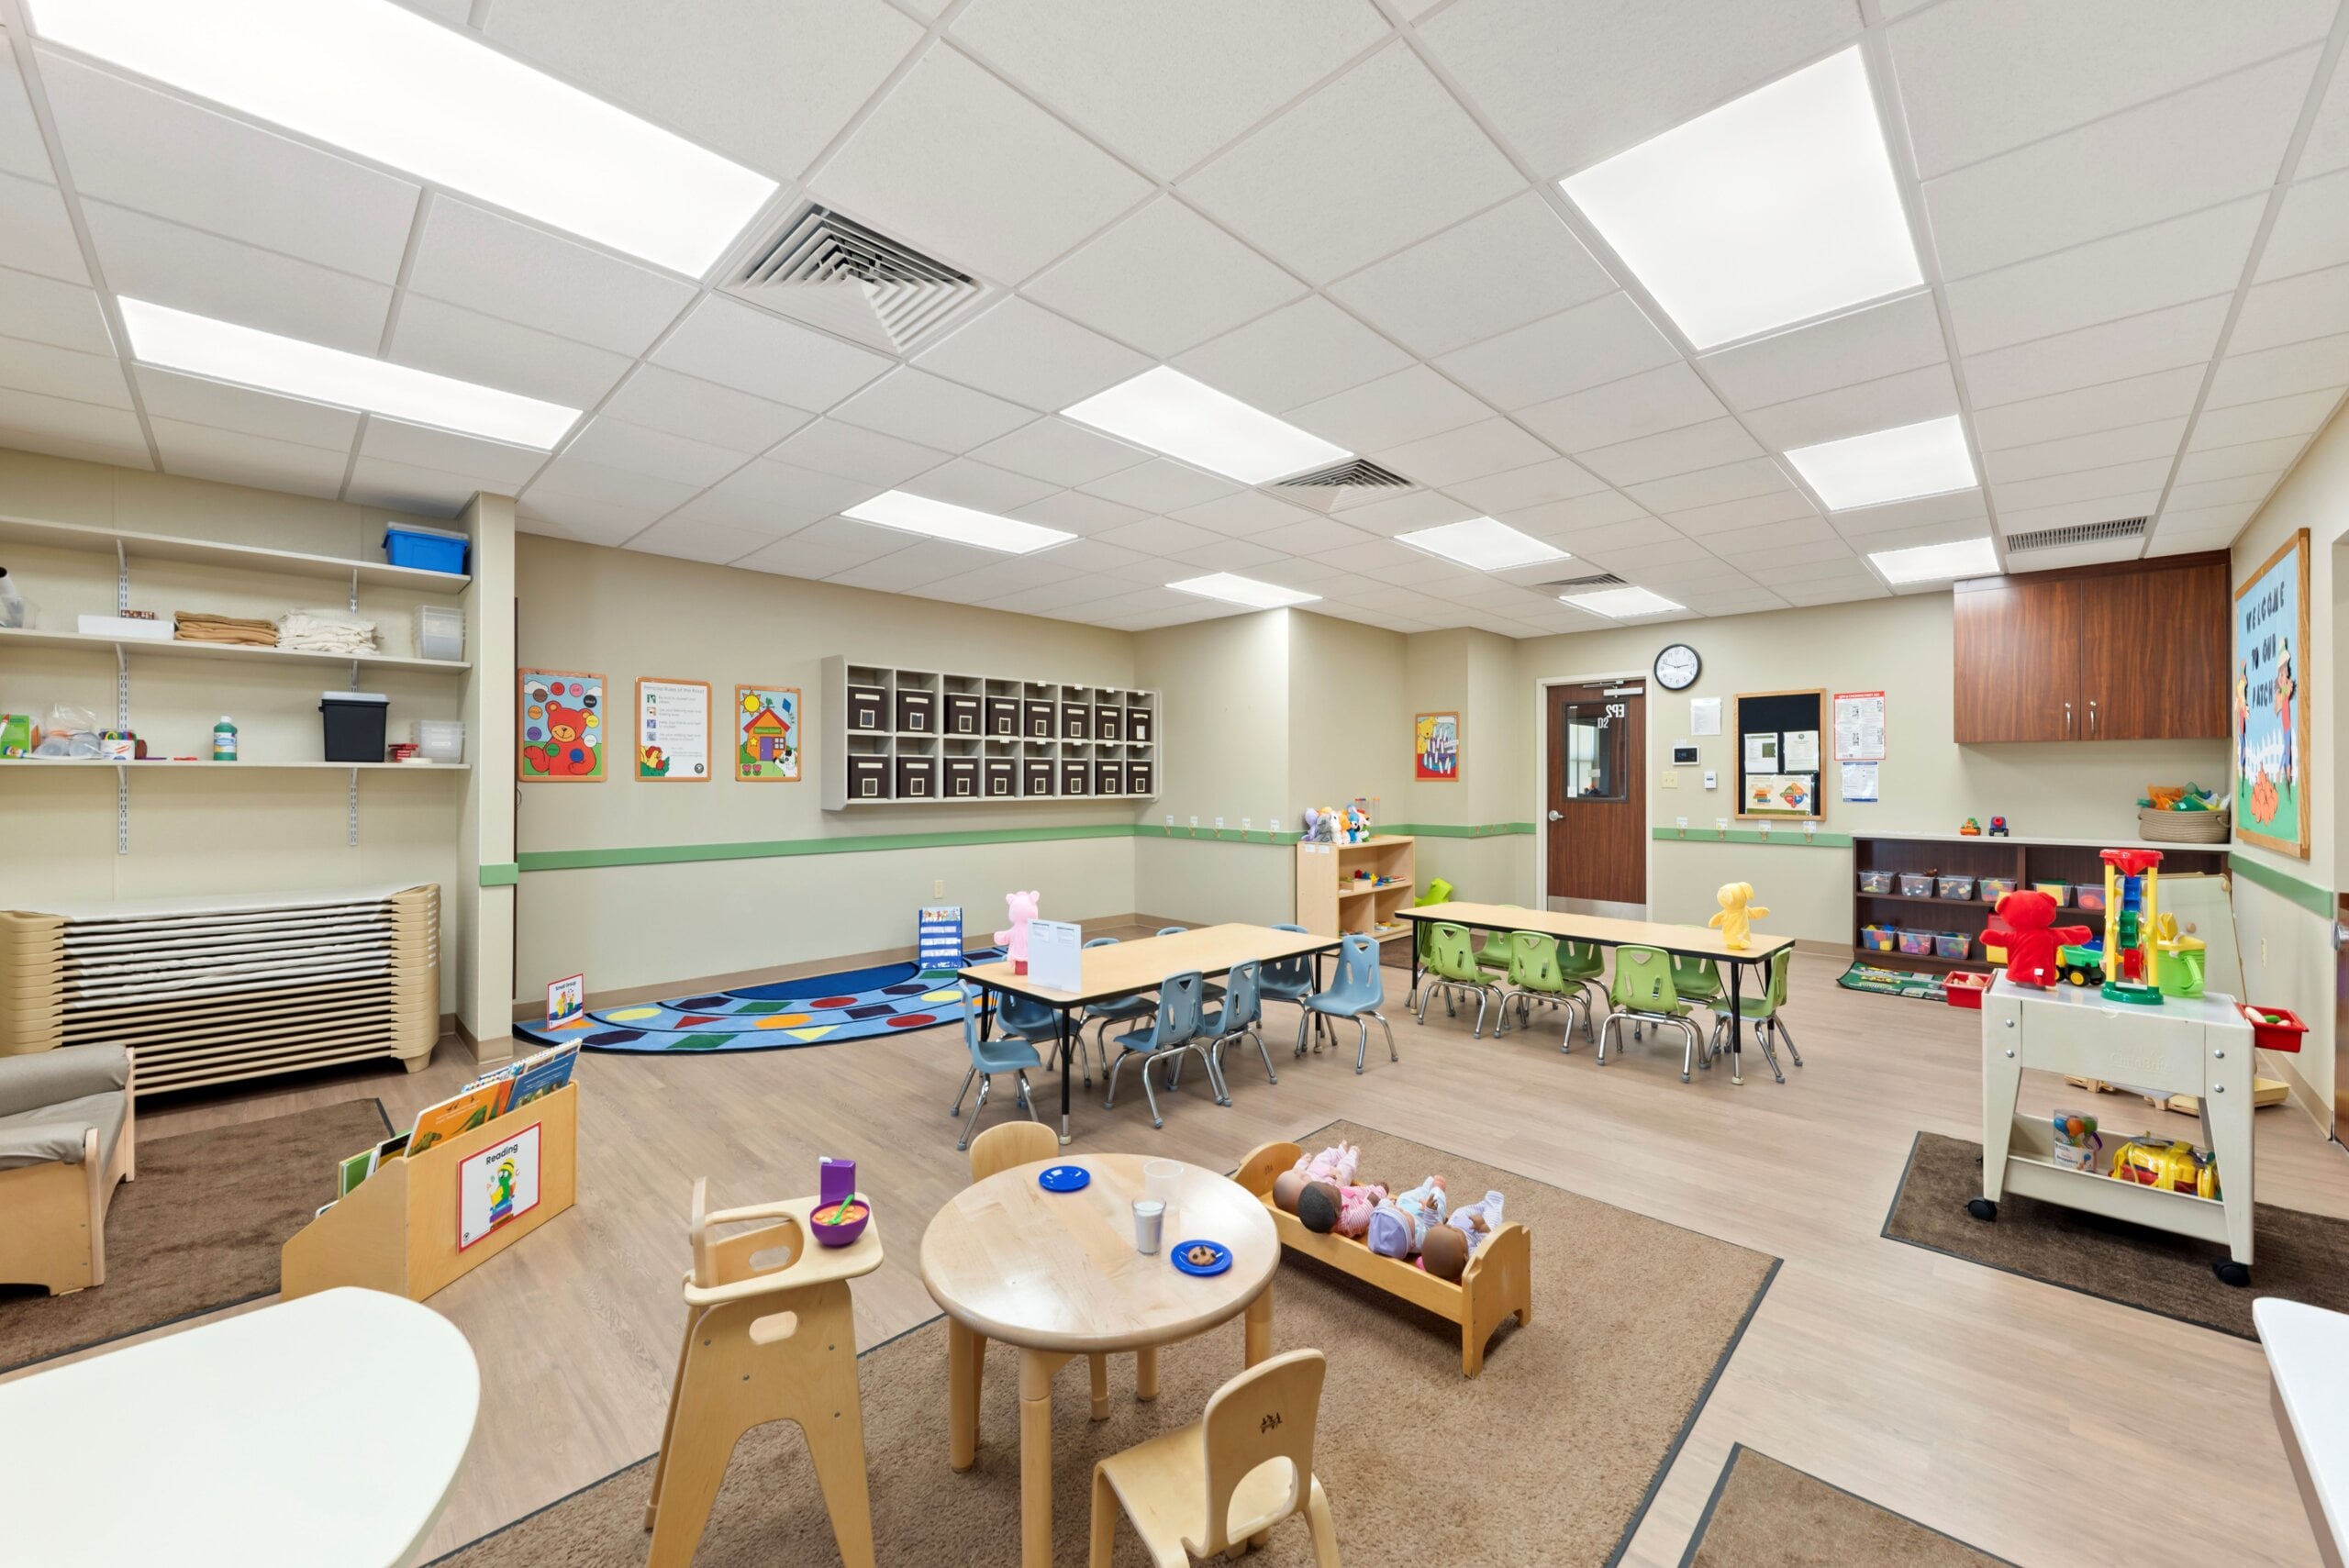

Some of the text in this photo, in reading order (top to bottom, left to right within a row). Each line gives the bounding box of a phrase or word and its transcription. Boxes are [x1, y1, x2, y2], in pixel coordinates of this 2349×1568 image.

[2245, 581, 2285, 634] WELCOME
[2251, 633, 2277, 671] TO OUR
[2252, 679, 2274, 709] PATCH
[1598, 717, 1609, 728] D2
[485, 1143, 518, 1165] Reading
